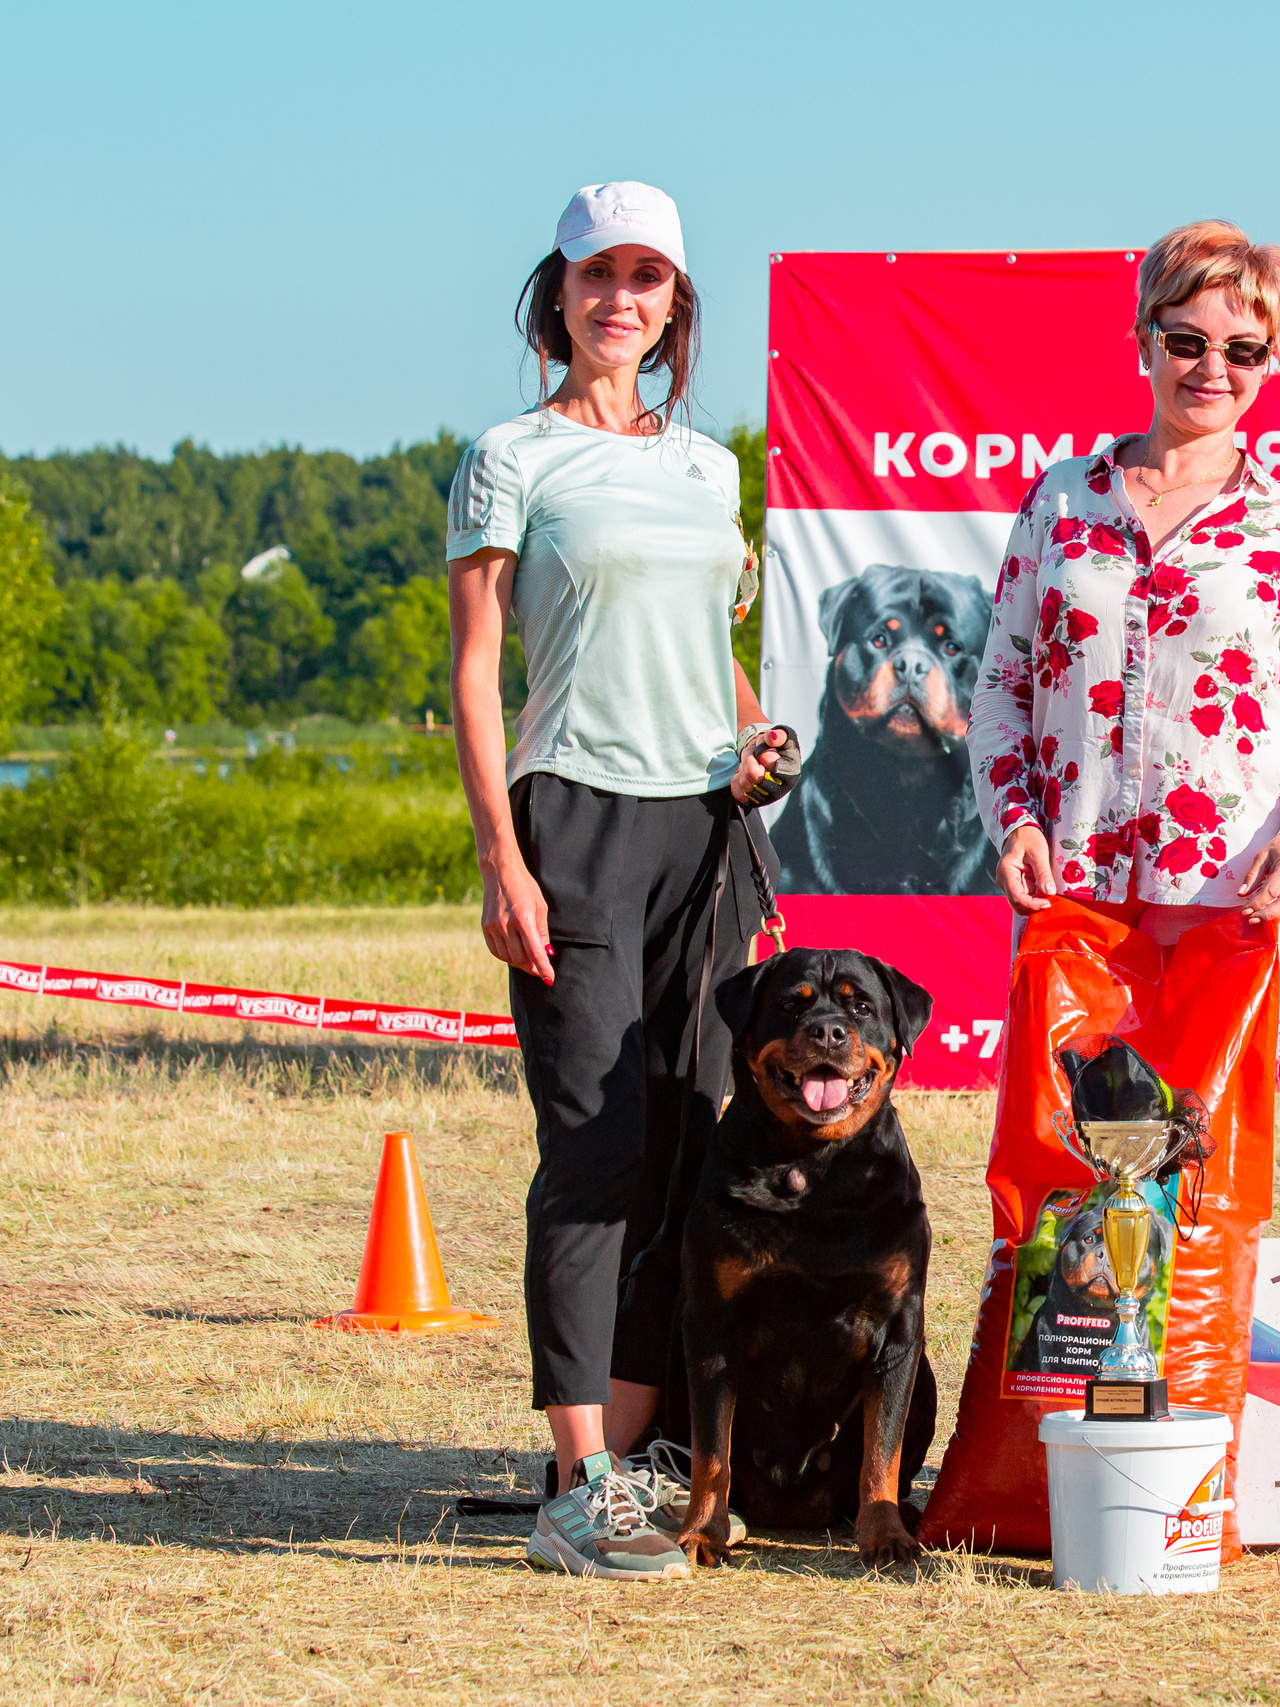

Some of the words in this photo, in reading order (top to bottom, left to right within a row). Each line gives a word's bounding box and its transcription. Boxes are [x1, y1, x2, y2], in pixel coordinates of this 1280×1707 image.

[686, 472, 706, 482] adidas
[0, 966, 40, 988] ТРАП
[99, 982, 178, 1007] ТРАПЕЗА
[239, 998, 318, 1022] ТРАПЕЗА
[378, 1013, 459, 1037] ТРАПЕЗА
[941, 1019, 1004, 1058] +7
[1056, 1313, 1112, 1329] PROFIFEED
[1038, 1334, 1112, 1347] ПОЛНОРАЦИОНН
[1066, 1346, 1092, 1356] КОРМ
[1041, 1355, 1059, 1364] ДЛЯ
[1060, 1356, 1099, 1367] ЧЕМПИО
[1016, 1385, 1064, 1394] КОРМЛЕНИЮ
[1065, 1387, 1085, 1396] ВАШ
